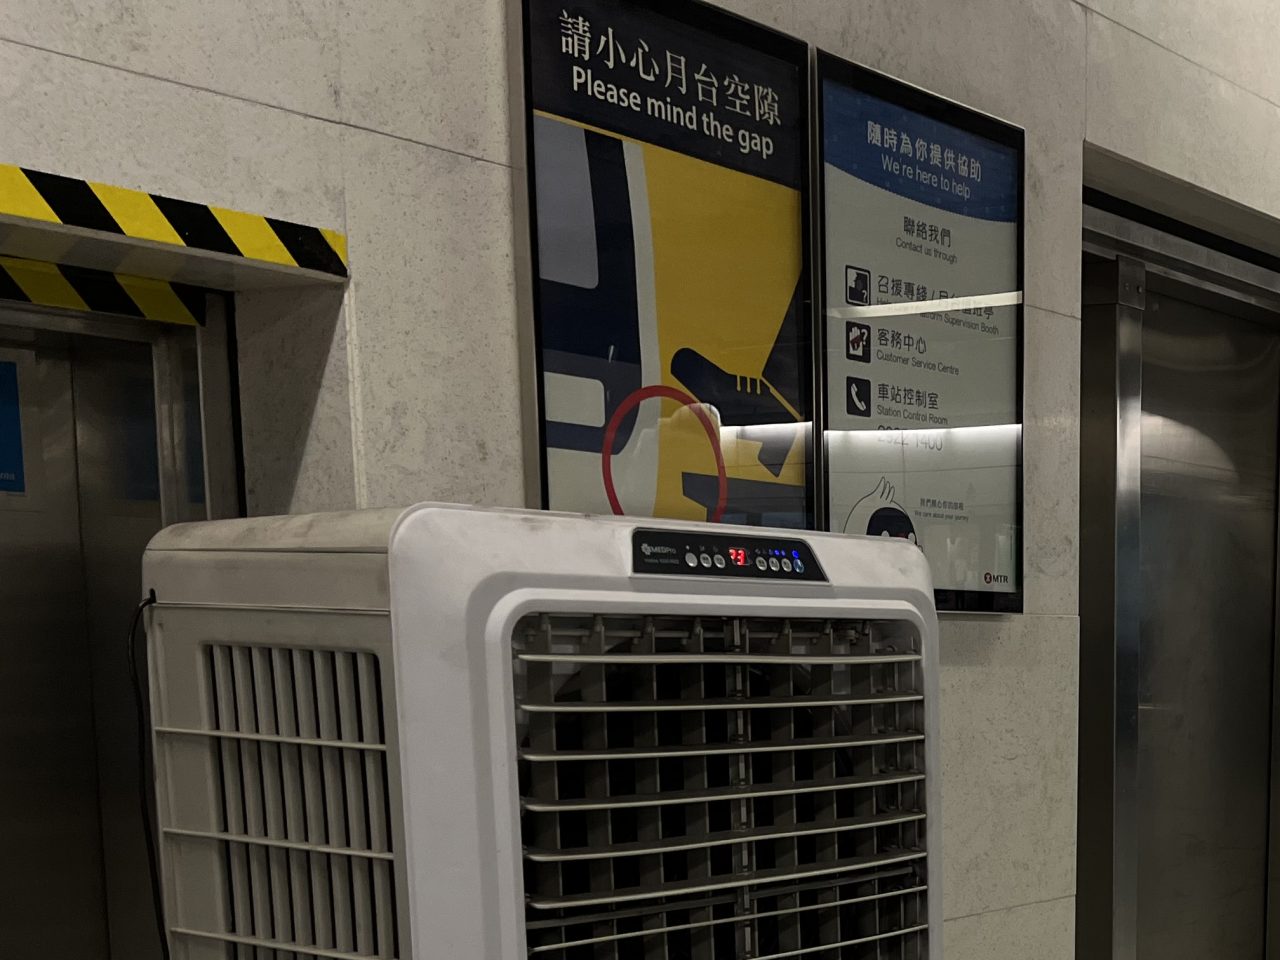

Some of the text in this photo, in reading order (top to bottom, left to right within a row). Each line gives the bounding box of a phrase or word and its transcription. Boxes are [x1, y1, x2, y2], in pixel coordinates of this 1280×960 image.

[559, 9, 782, 126] 請小心月台空隙
[572, 66, 774, 159] Please mind the gap
[867, 120, 982, 182] 隨時為你提供協助
[881, 154, 971, 200] We're here to help
[904, 216, 951, 248] 聯絡我們
[896, 237, 958, 264] Contact us through
[944, 313, 979, 331] Supervision
[981, 322, 999, 336] Booth
[877, 328, 927, 354] 客務中心
[876, 350, 960, 376] Customer Service Centre
[877, 383, 939, 410] 車站控制室
[876, 404, 949, 425] Station Control Room
[992, 574, 1009, 584] MTR
